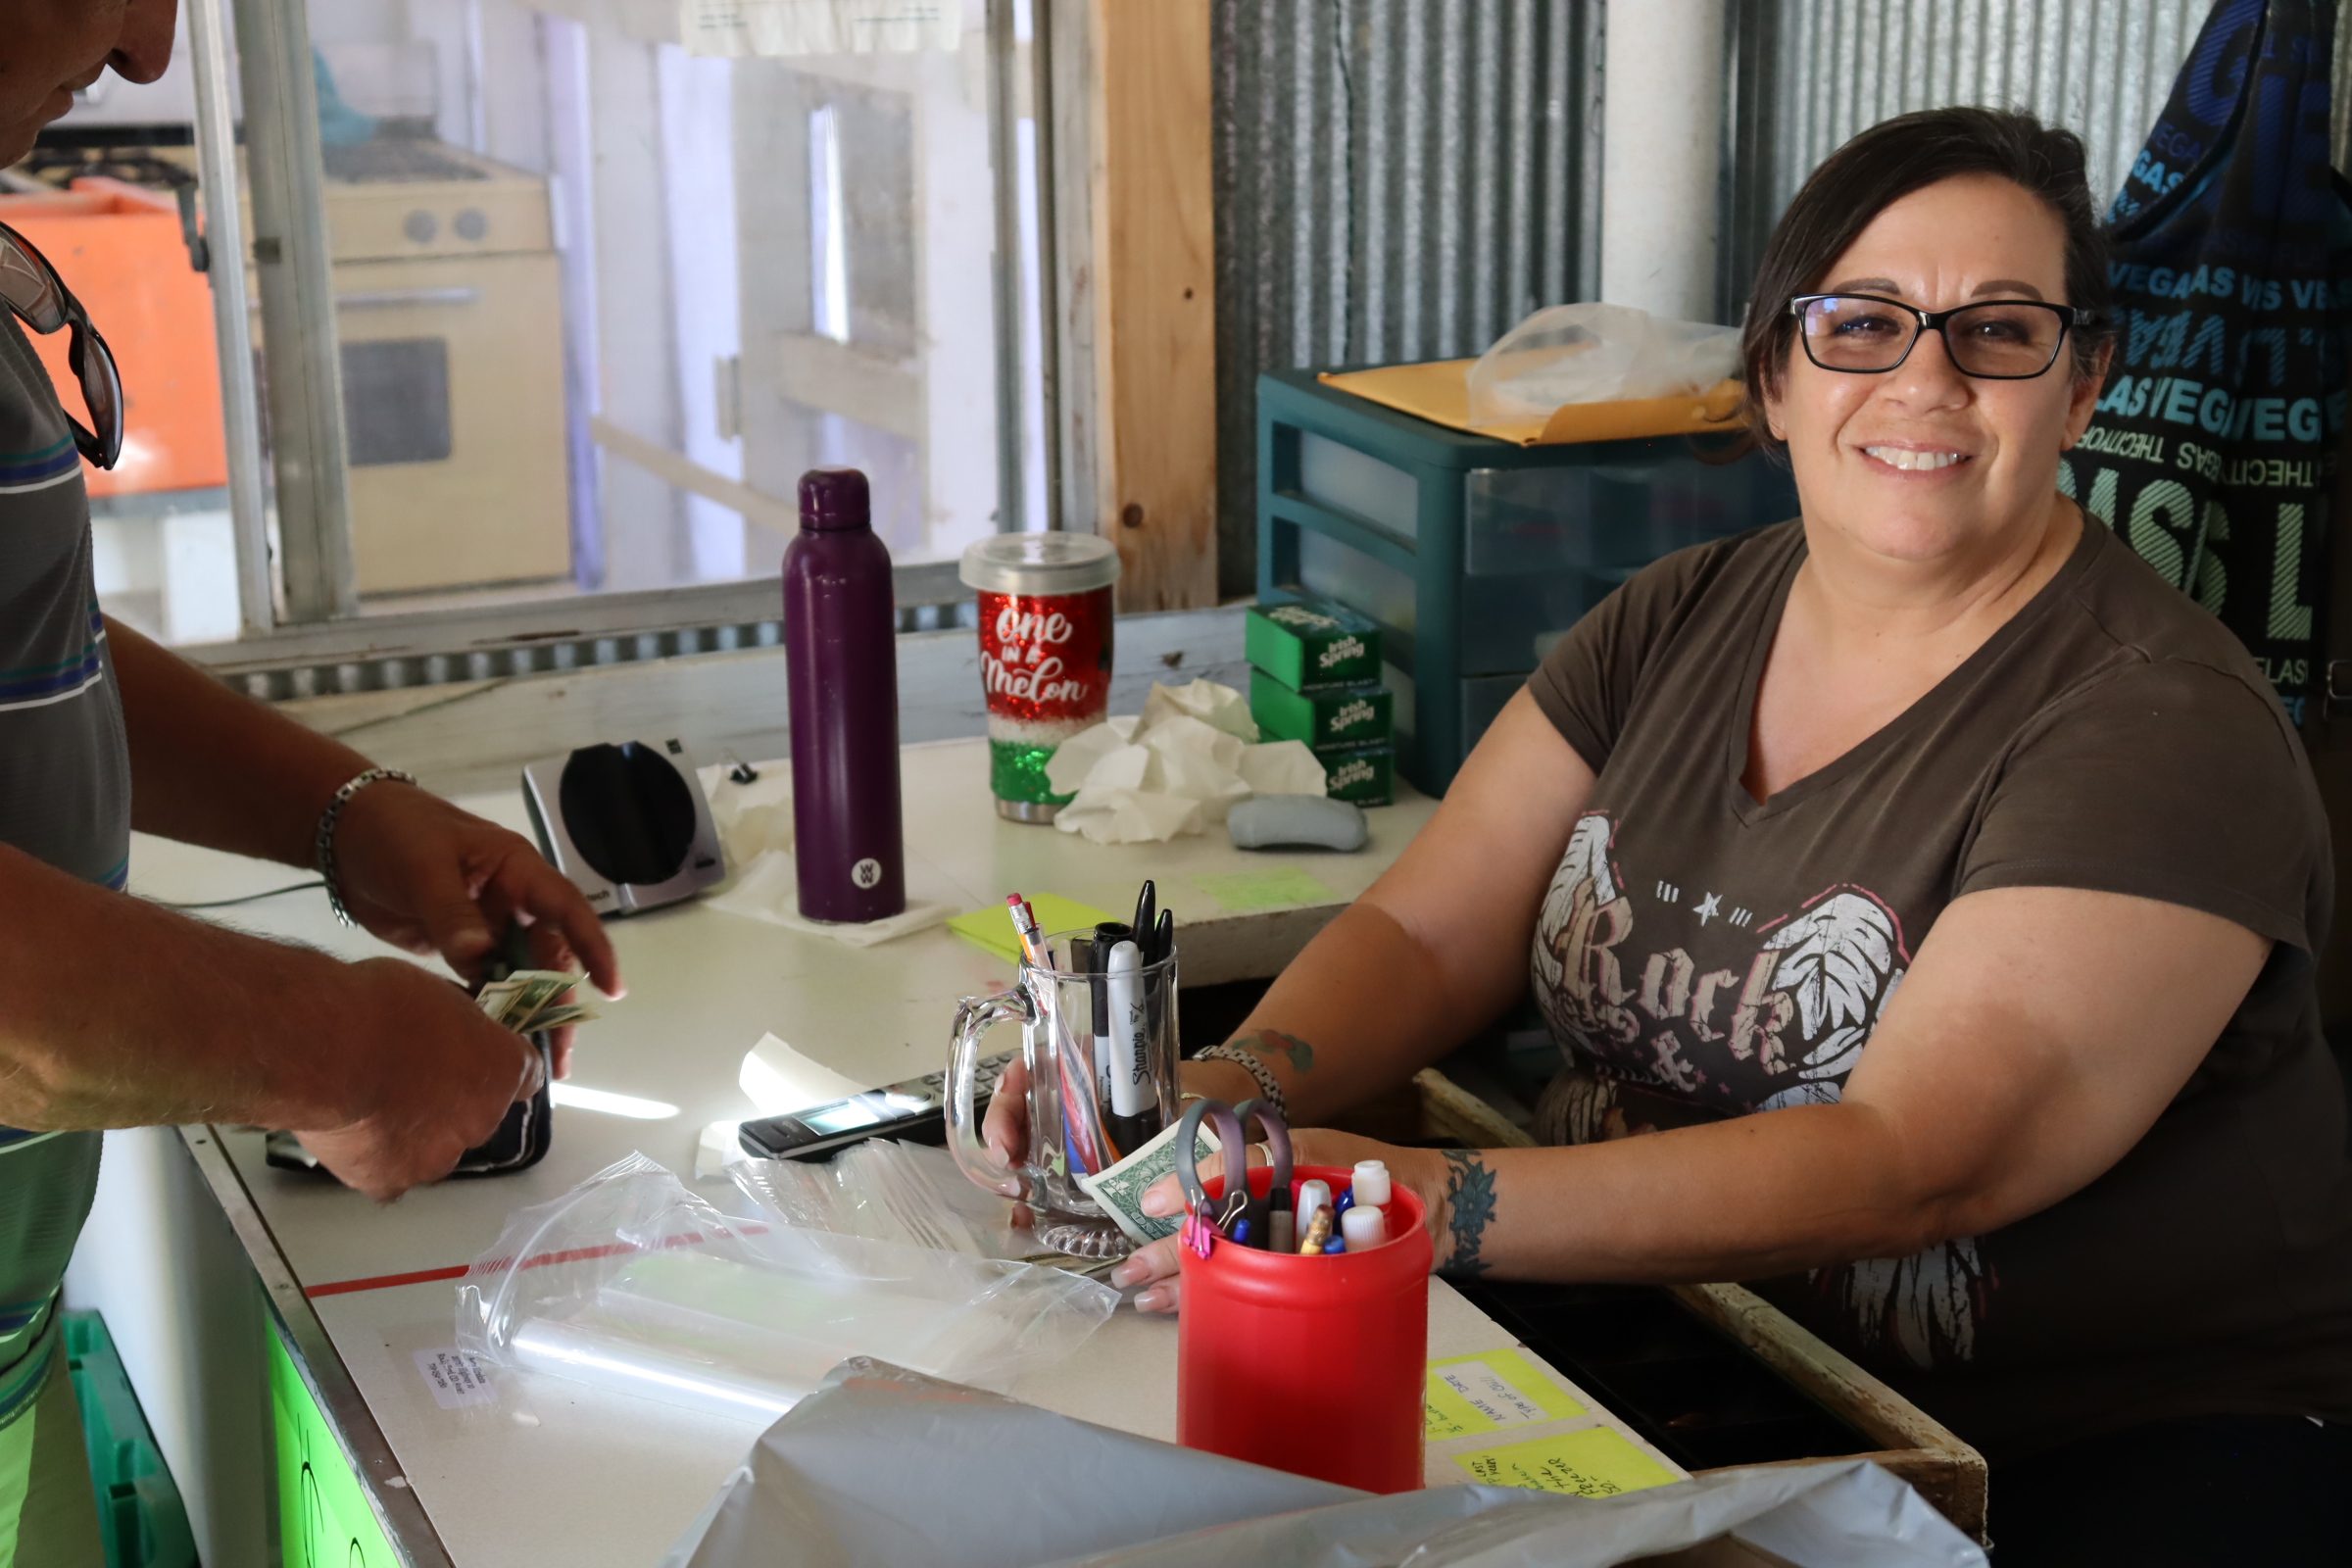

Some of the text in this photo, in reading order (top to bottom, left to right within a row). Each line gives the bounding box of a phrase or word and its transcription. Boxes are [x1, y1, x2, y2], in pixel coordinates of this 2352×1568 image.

[1319, 643, 1365, 668] Spring
[1328, 635, 1357, 654] Irish
[1330, 706, 1375, 733] Spring
[1340, 699, 1367, 717] Irish
[1329, 766, 1375, 791] Spring
[1338, 759, 1367, 777] Irish
[1133, 1028, 1152, 1085] Sharpie
